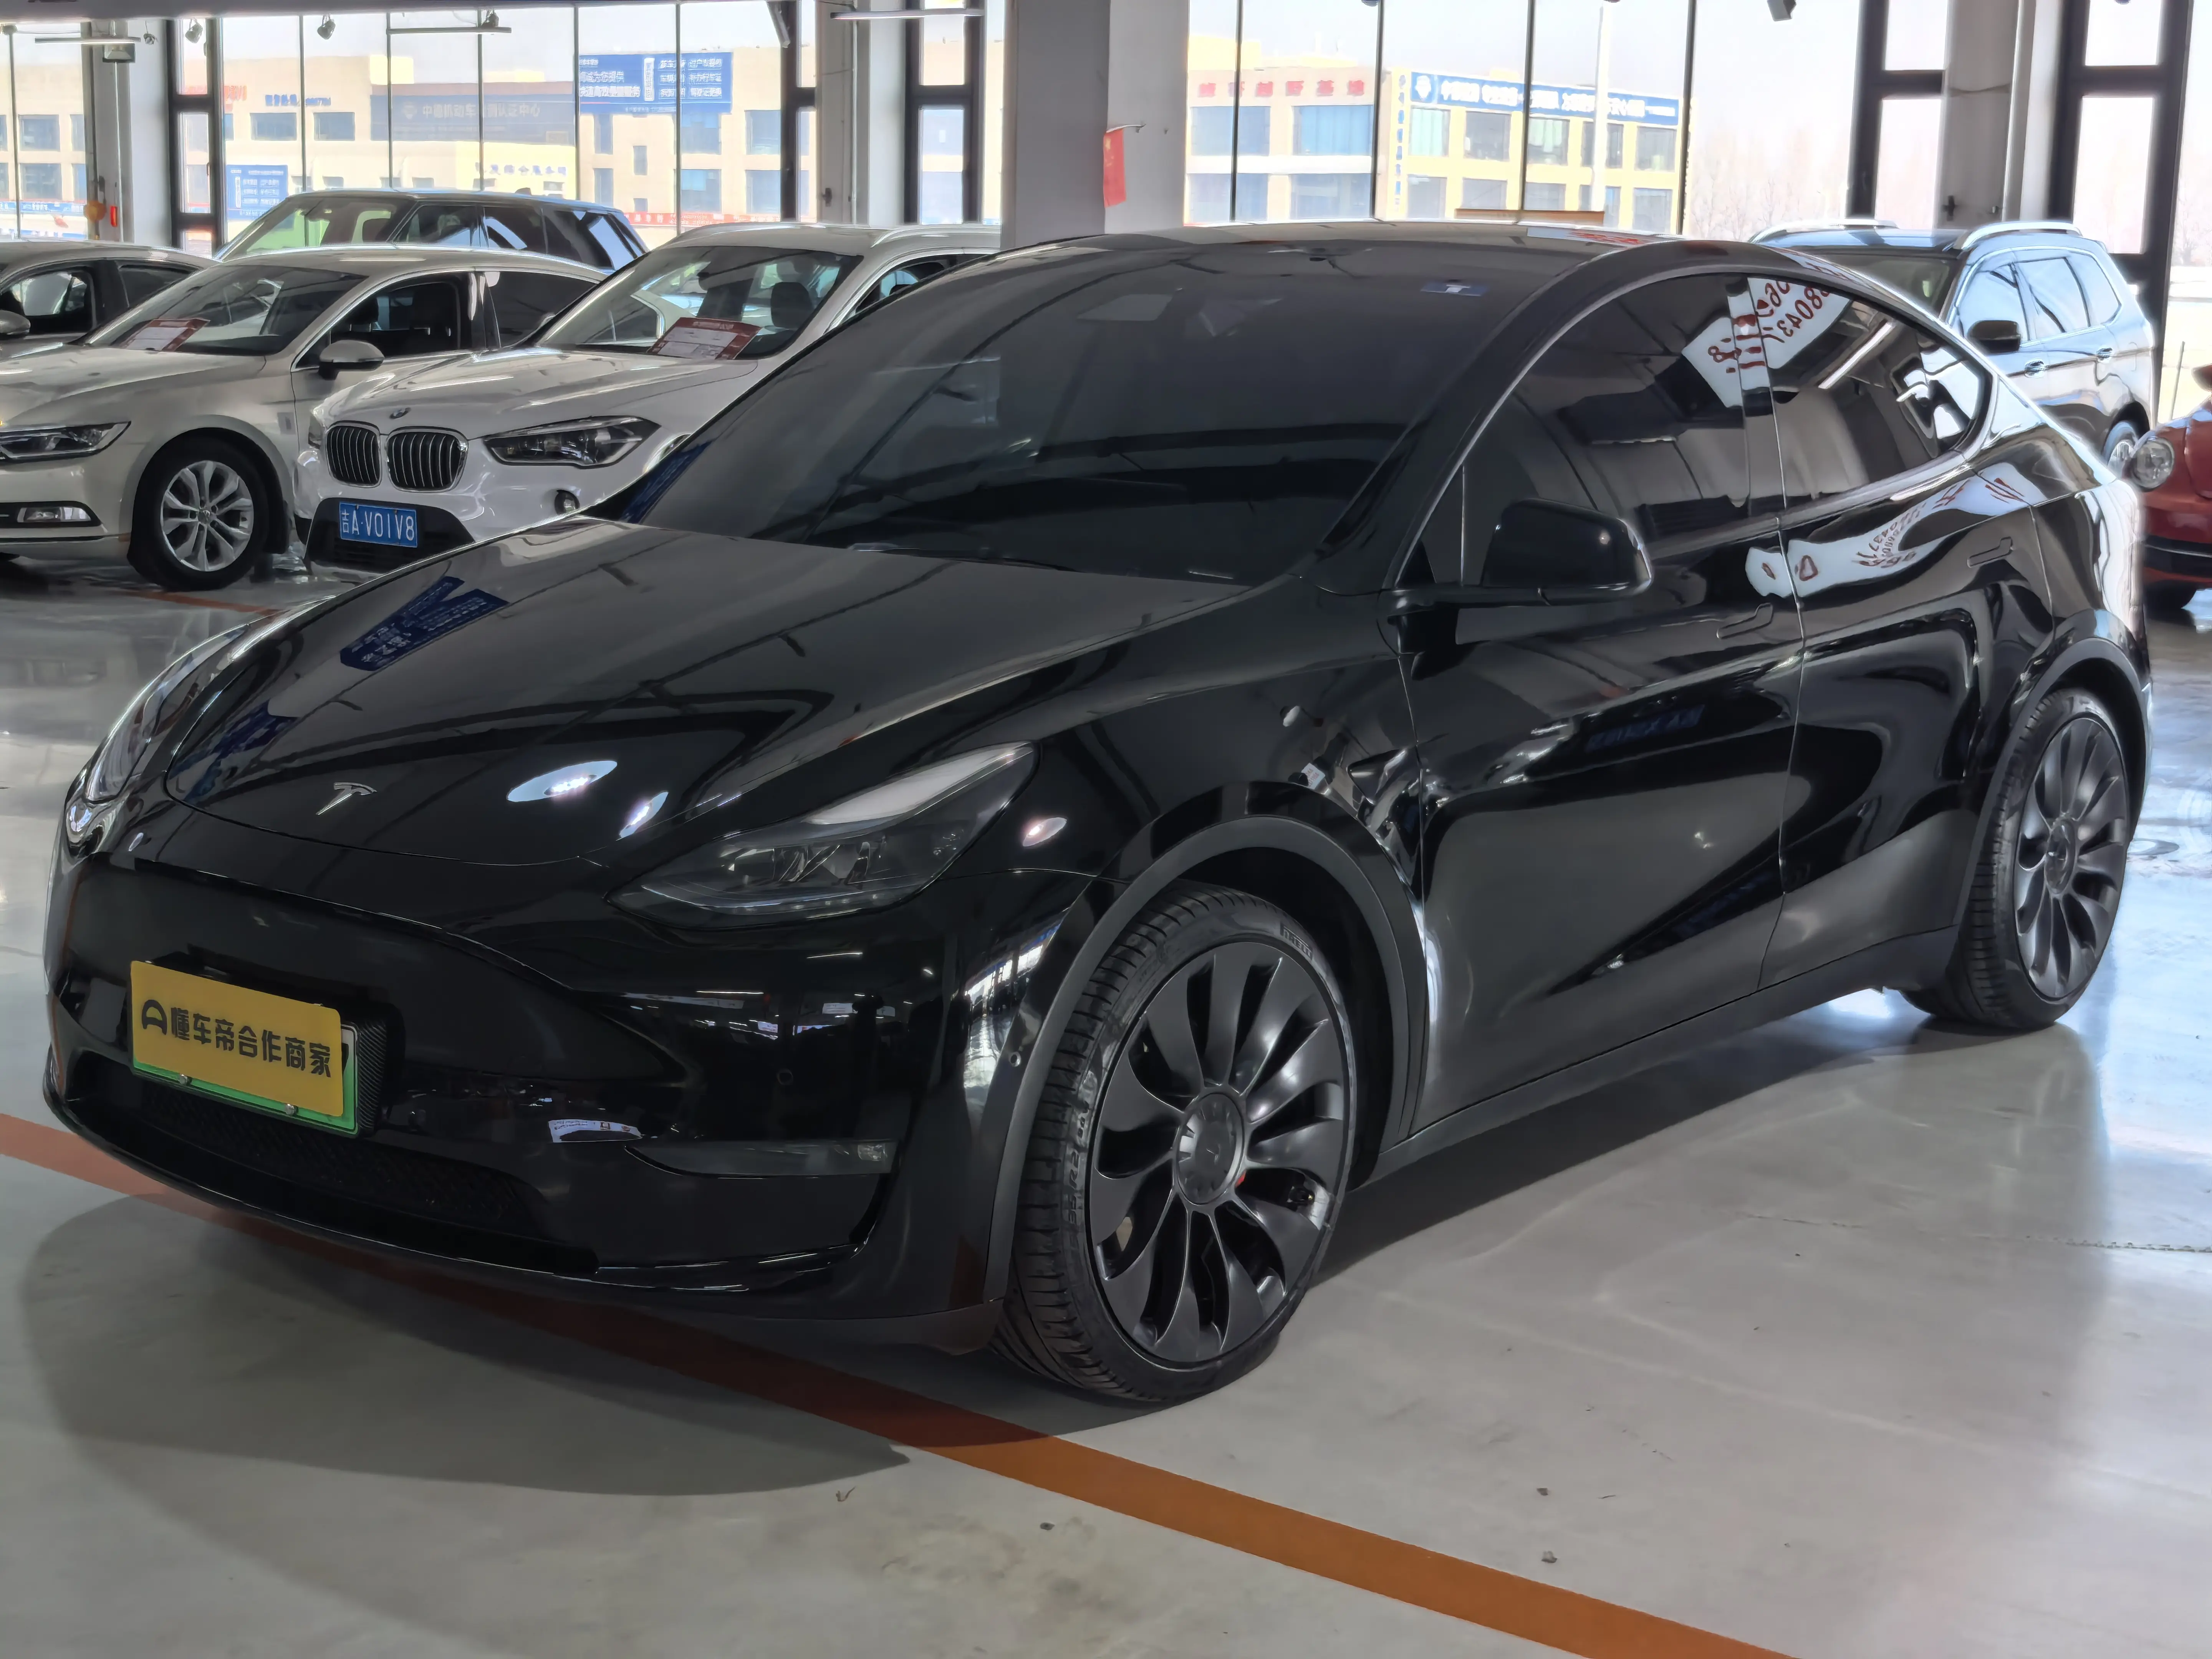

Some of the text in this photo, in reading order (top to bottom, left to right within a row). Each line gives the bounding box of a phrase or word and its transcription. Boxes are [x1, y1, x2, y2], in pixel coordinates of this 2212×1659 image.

[171, 1007, 331, 1078] 懂车帝合作商家
